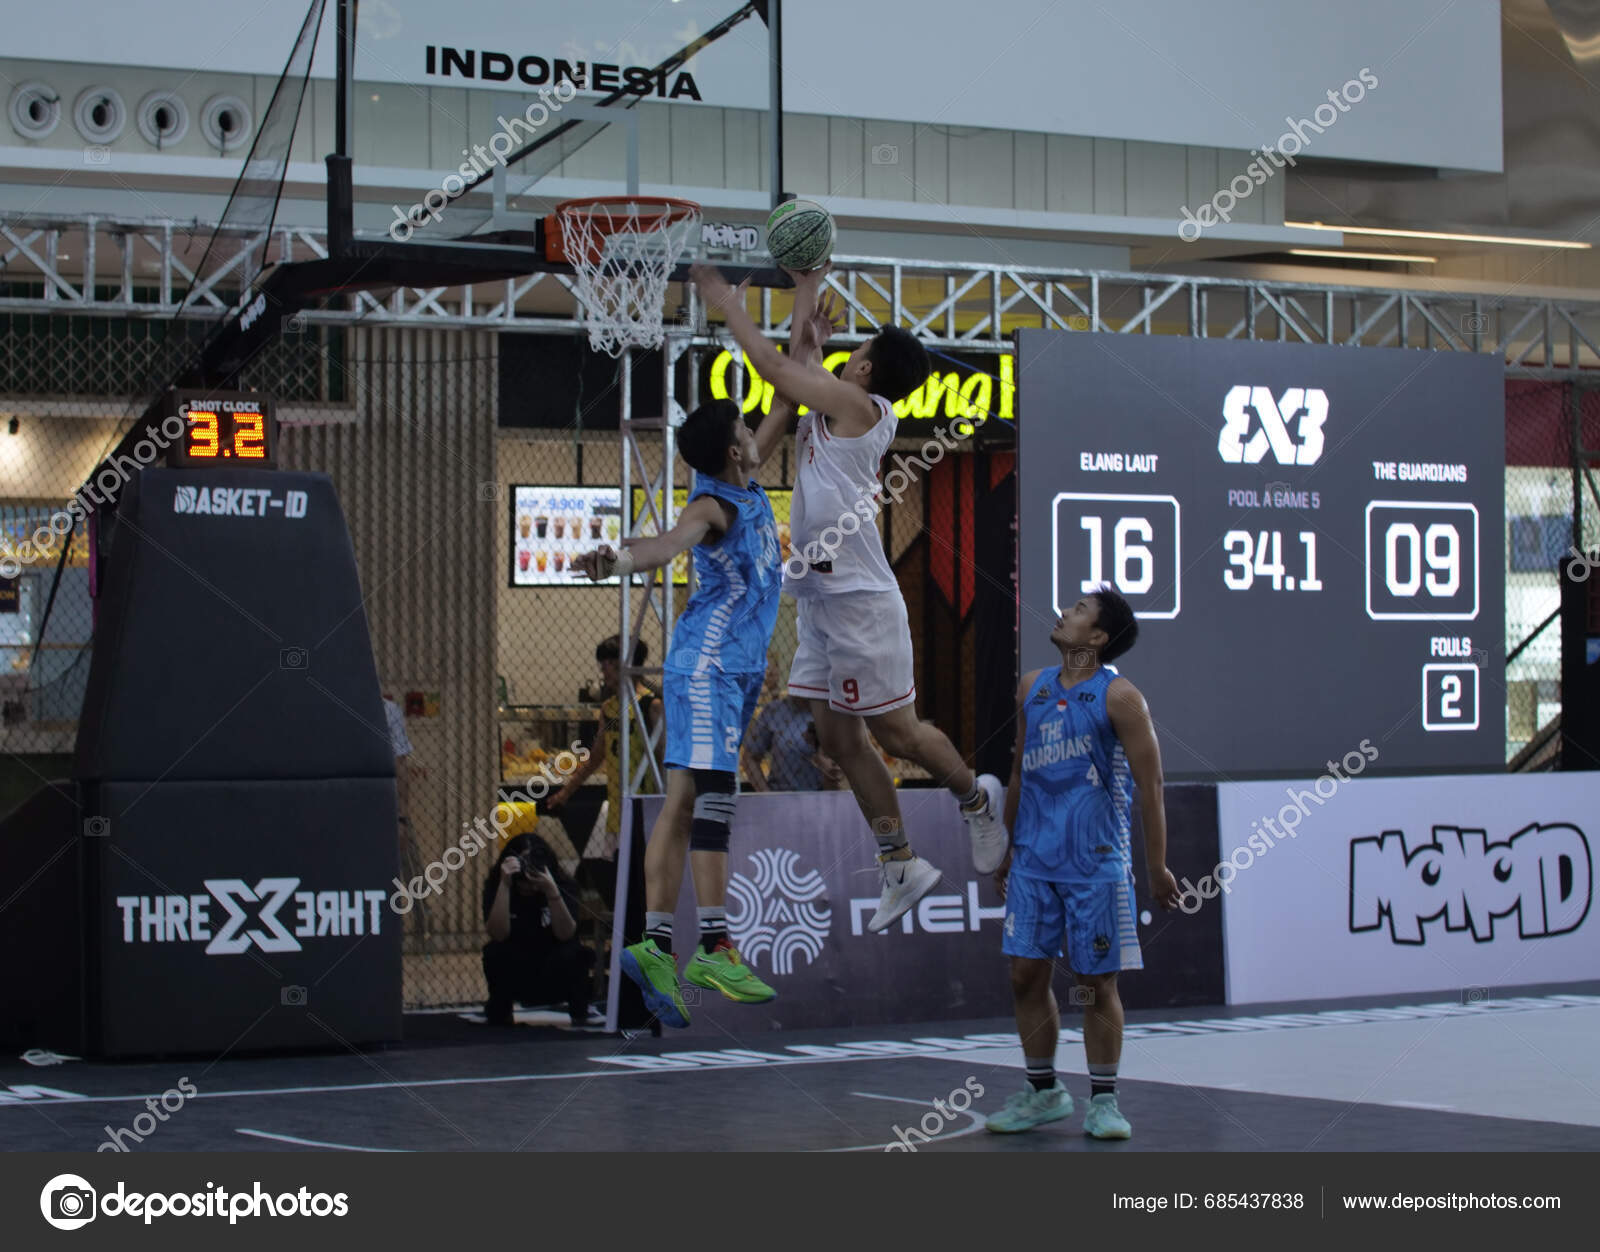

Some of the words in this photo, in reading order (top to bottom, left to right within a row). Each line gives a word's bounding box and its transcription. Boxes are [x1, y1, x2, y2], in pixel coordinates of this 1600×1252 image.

[426, 45, 703, 101] INDONESIA
[190, 400, 221, 412] SHOT
[223, 400, 260, 412] CLOCK
[187, 411, 265, 459] 3.2
[1080, 452, 1123, 472] ELANG
[1125, 453, 1158, 473] LAUT
[1373, 462, 1397, 480] THE
[1398, 462, 1467, 482] GUARDIANS
[174, 485, 308, 519] BASKET-ID
[1228, 489, 1261, 508] POOL
[1263, 490, 1273, 508] A
[1274, 490, 1310, 509] GAME
[1312, 492, 1321, 509] 5
[1080, 516, 1153, 594] 16
[1223, 530, 1323, 592] 34.1
[1385, 522, 1460, 597] 09
[1430, 636, 1472, 657] FOULS
[842, 678, 860, 704] 9
[1441, 675, 1462, 718] 2
[1039, 718, 1065, 745] THE
[1086, 763, 1100, 787] 4
